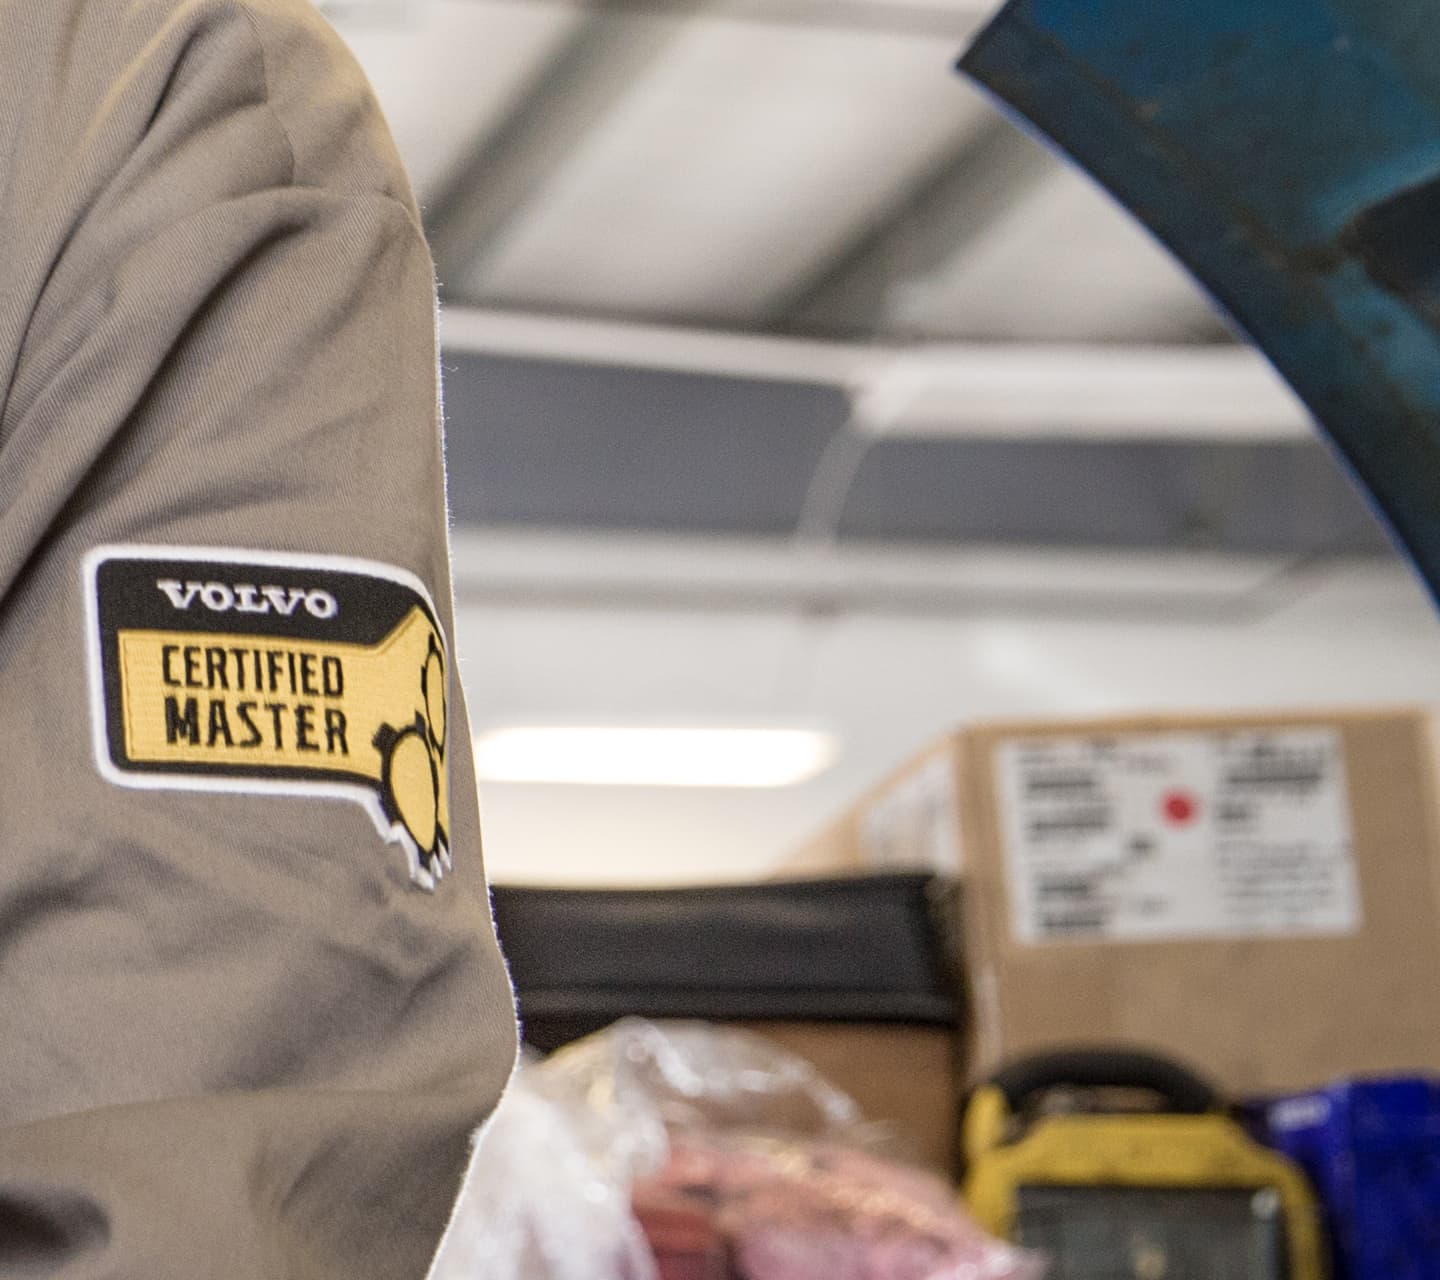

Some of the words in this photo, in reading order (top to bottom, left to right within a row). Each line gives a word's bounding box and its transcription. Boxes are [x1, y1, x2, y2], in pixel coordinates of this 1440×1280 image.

[156, 578, 339, 620] VOLVO
[161, 644, 345, 699] CERTIFIED
[163, 695, 350, 757] MASTER
